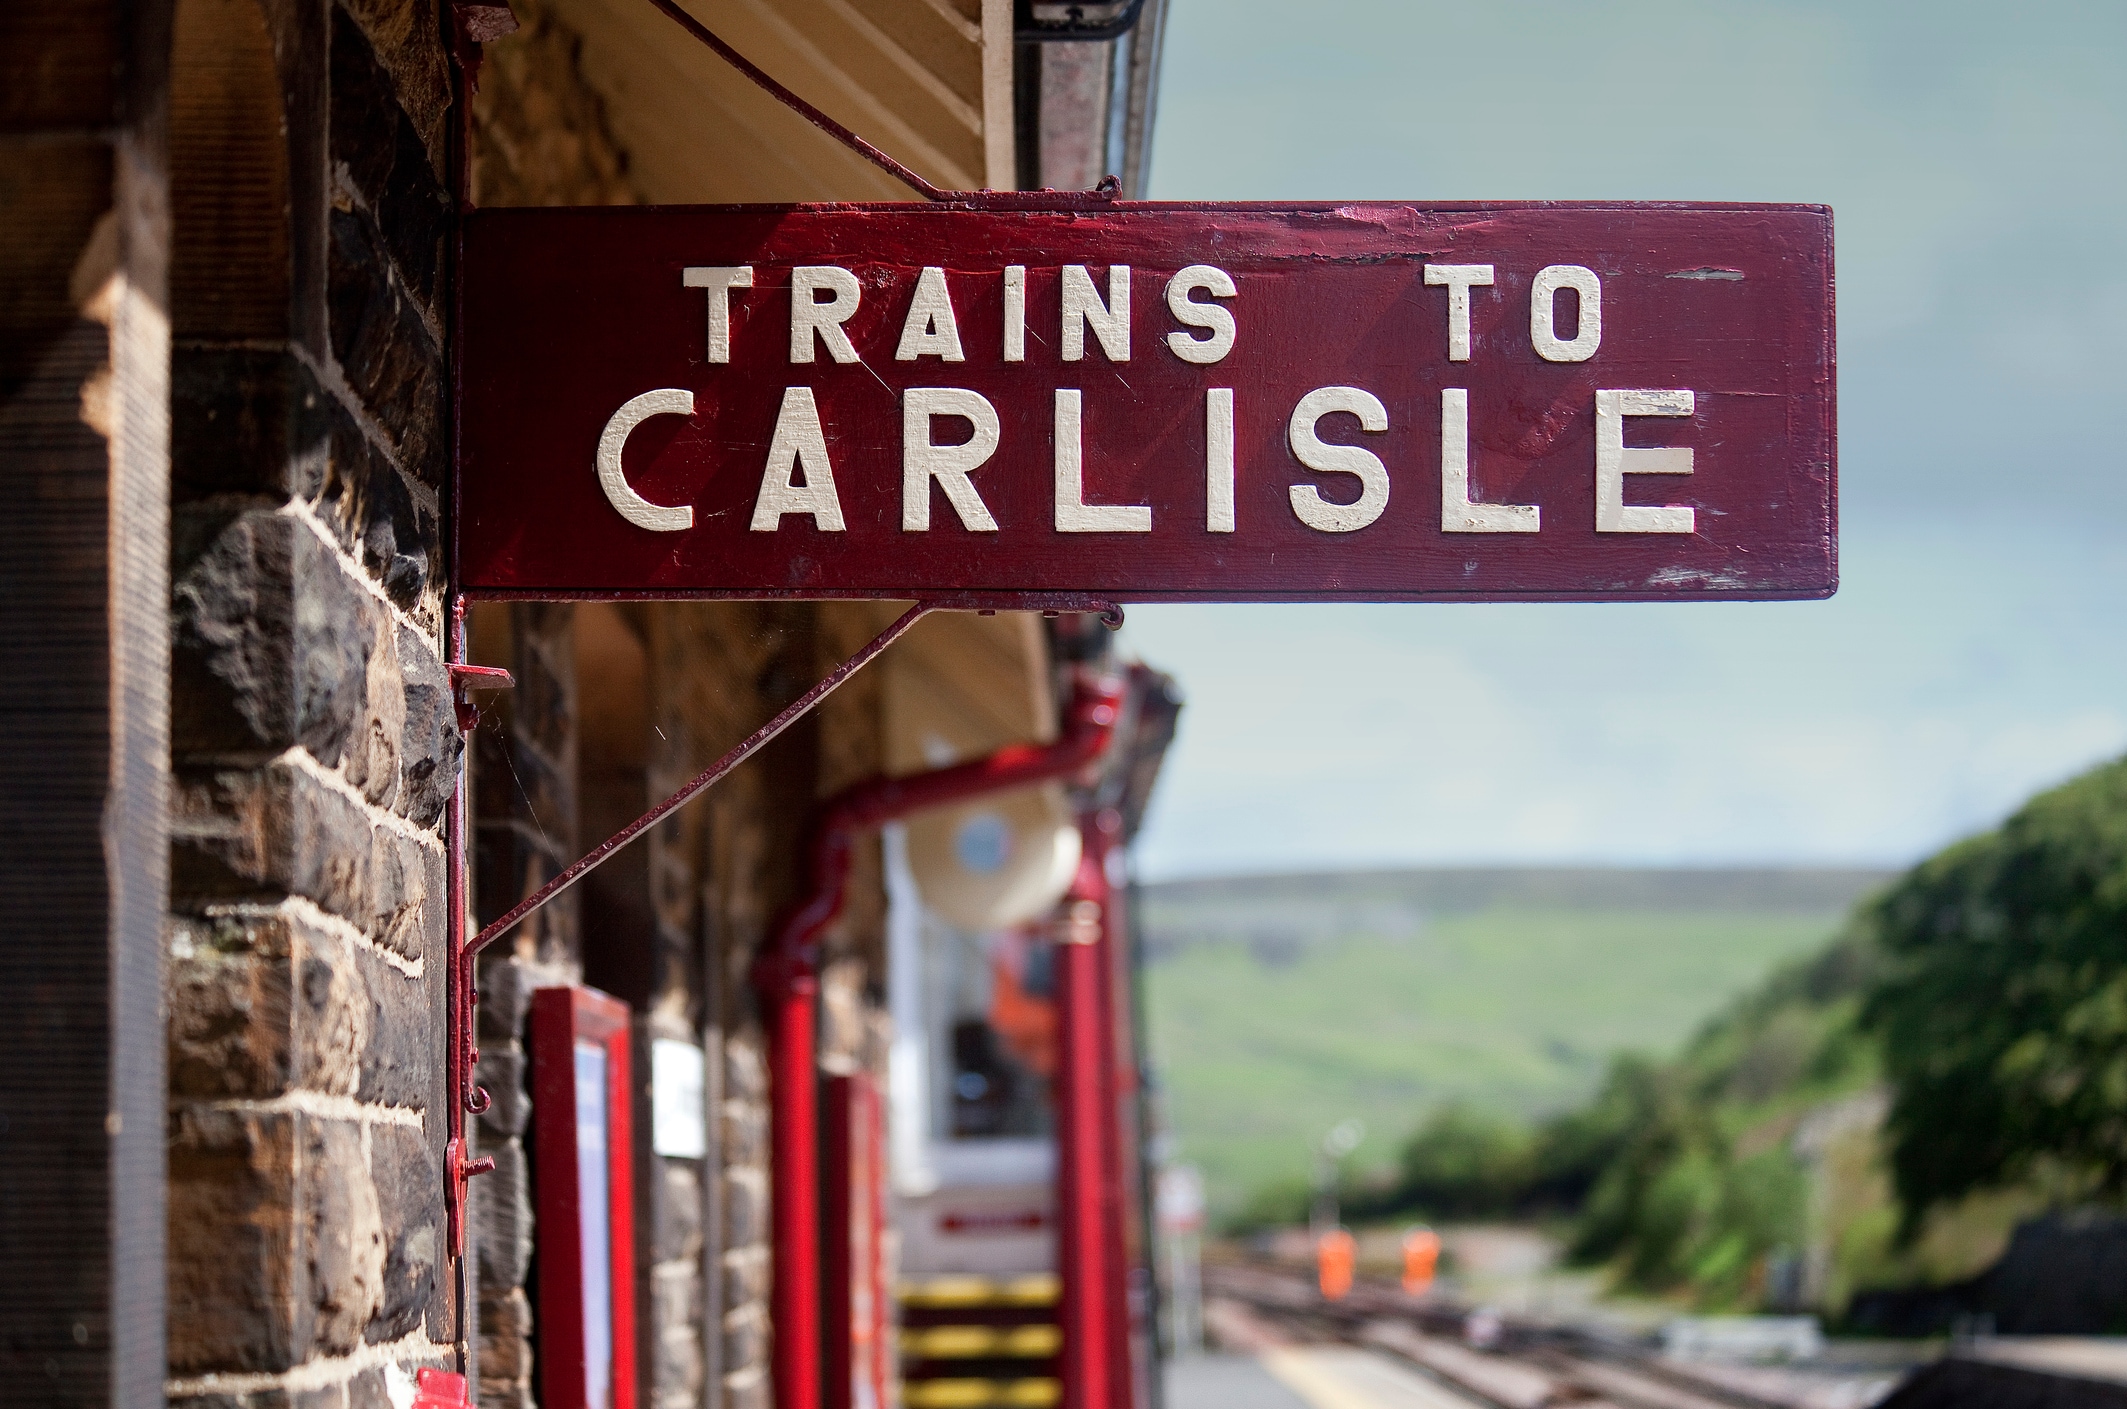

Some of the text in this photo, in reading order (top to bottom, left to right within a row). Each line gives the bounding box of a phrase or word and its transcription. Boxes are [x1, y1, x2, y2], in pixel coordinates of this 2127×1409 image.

[683, 263, 1603, 365] TRAINS TO
[597, 387, 1696, 534] CARLISLE
